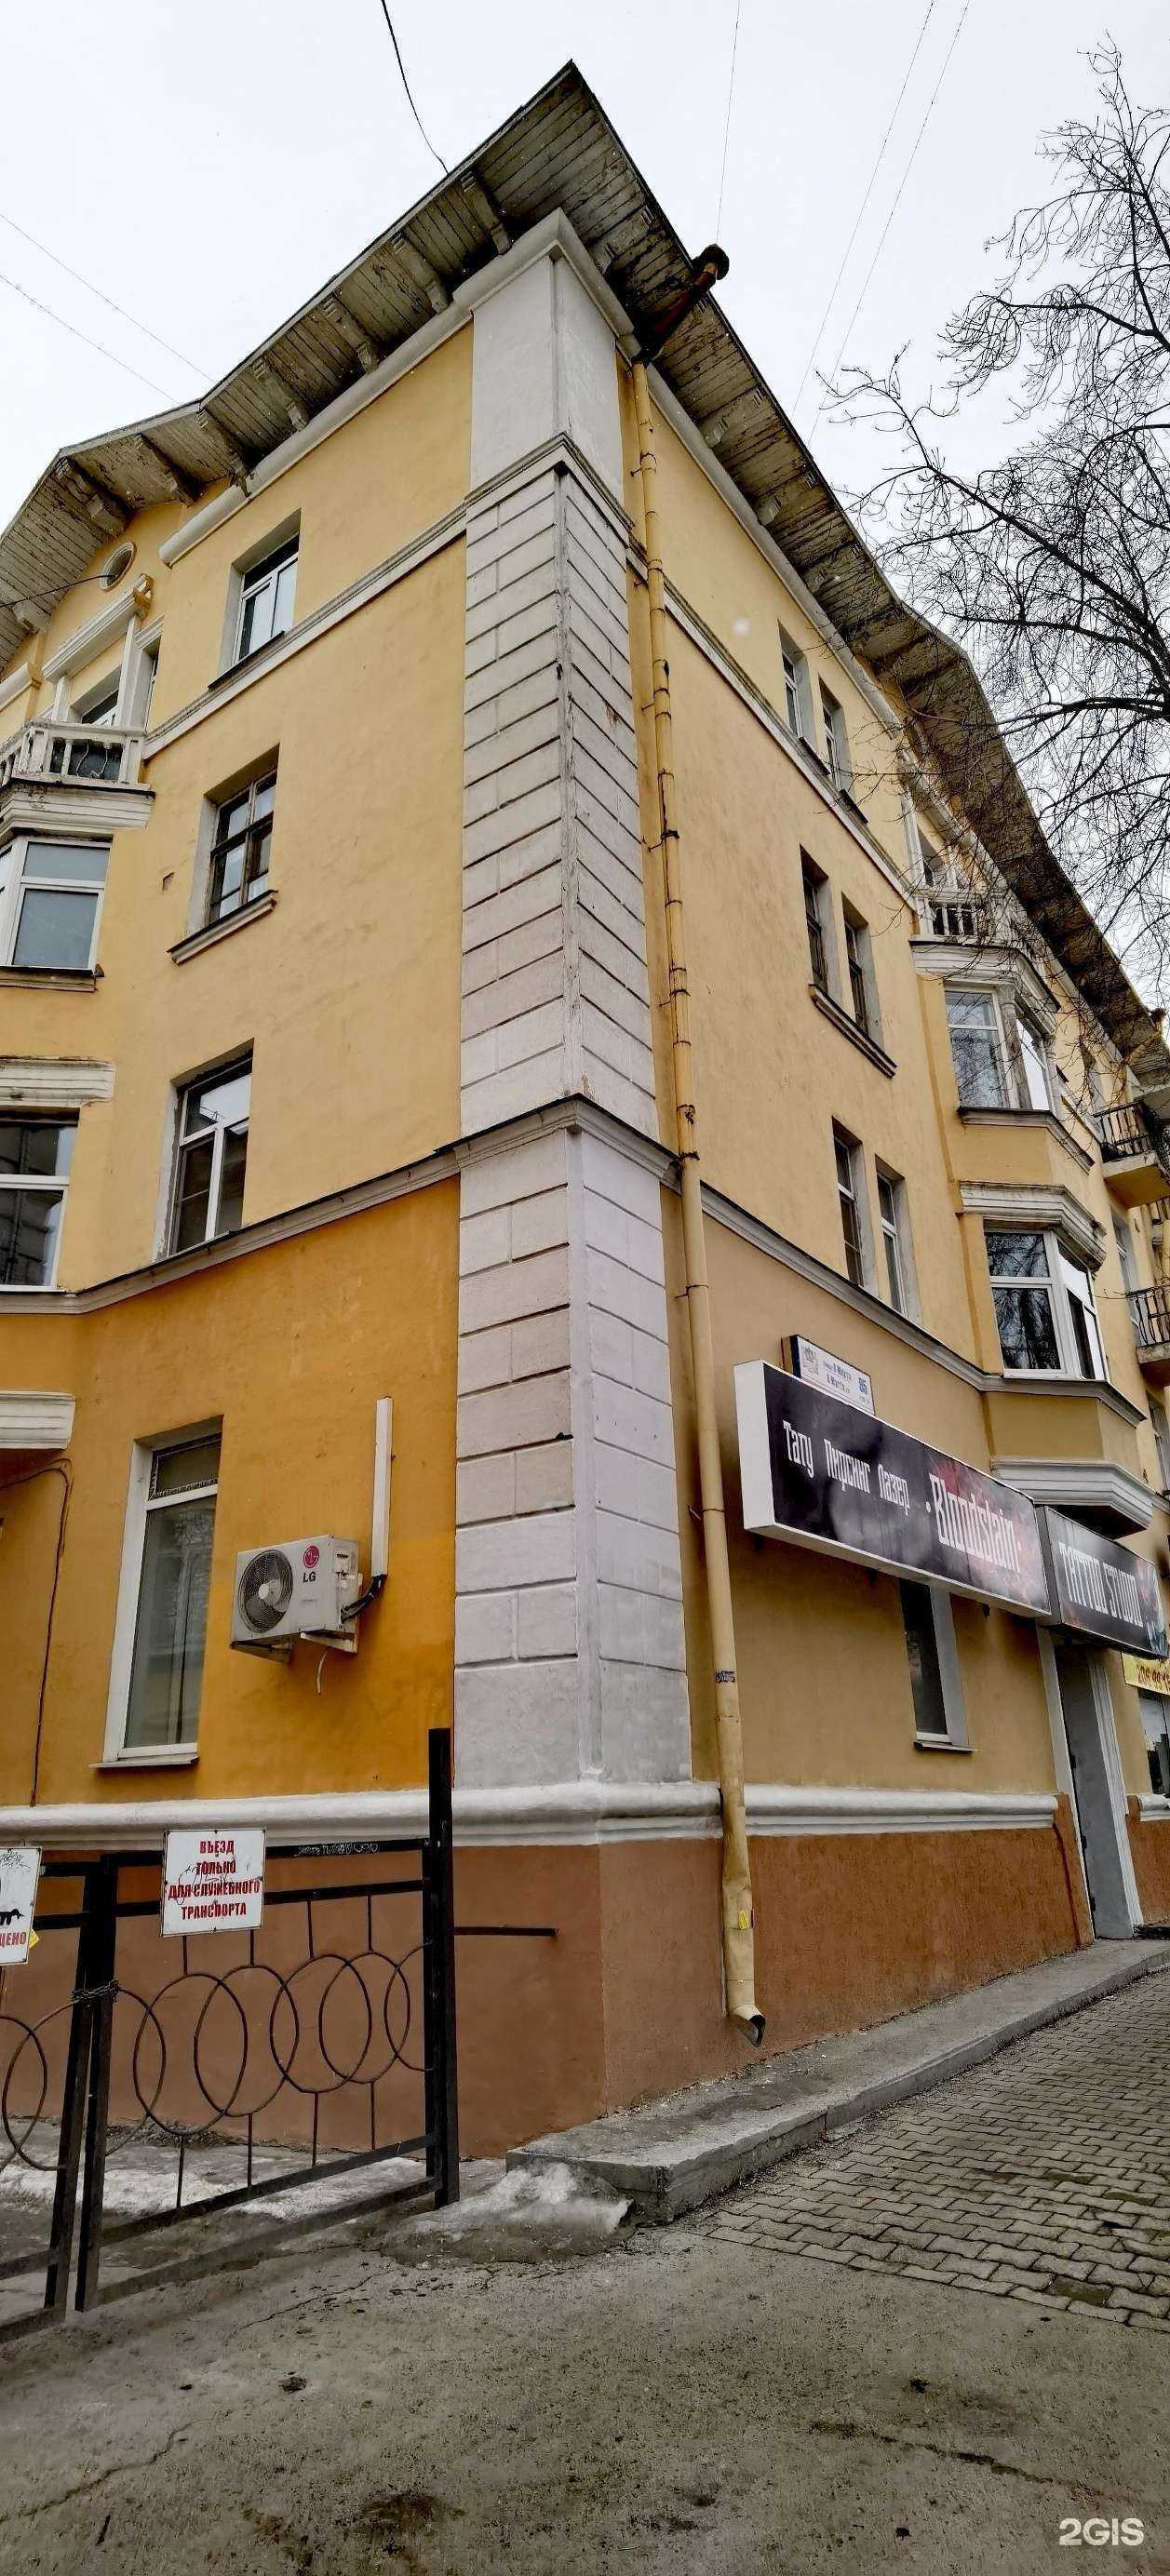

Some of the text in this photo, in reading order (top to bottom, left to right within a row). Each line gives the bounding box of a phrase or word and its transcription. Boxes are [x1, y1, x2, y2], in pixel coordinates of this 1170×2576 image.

[783, 1420, 910, 1517] Тату Пирсинг Лазер
[303, 1571, 316, 1582] LG
[1103, 1562, 1144, 1628] STUDIO
[196, 1861, 236, 1875] ТОЛЬКО
[193, 1880, 261, 1898] СЛУЖЕБНОГО
[182, 1902, 247, 1920] ТРАНСПОРТА
